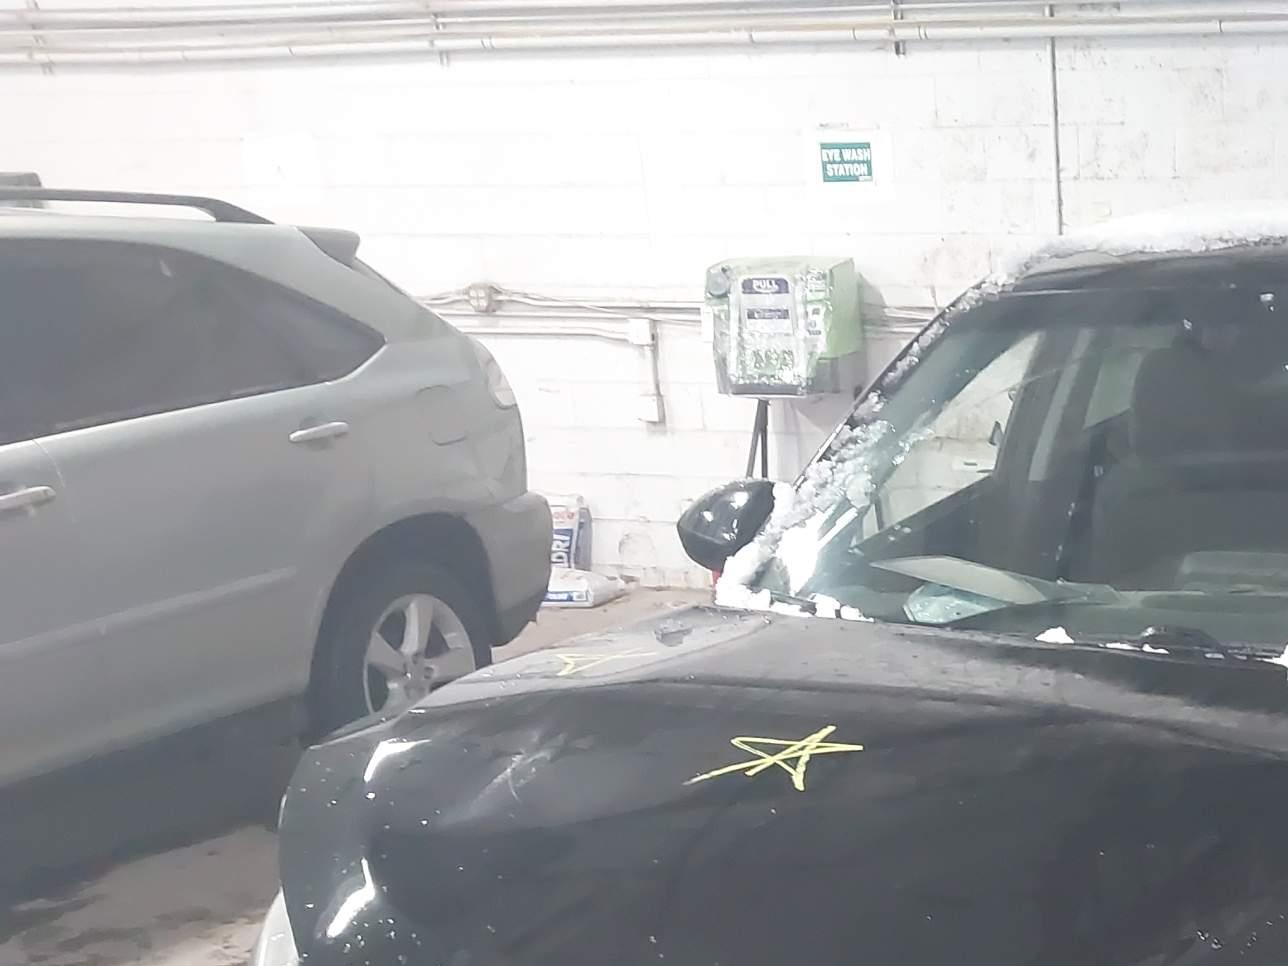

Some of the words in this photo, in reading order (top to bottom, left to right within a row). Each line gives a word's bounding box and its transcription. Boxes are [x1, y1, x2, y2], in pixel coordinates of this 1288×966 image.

[822, 149, 841, 162] EYE
[841, 148, 870, 161] WASH
[826, 163, 868, 176] STATION
[752, 279, 778, 289] PULL
